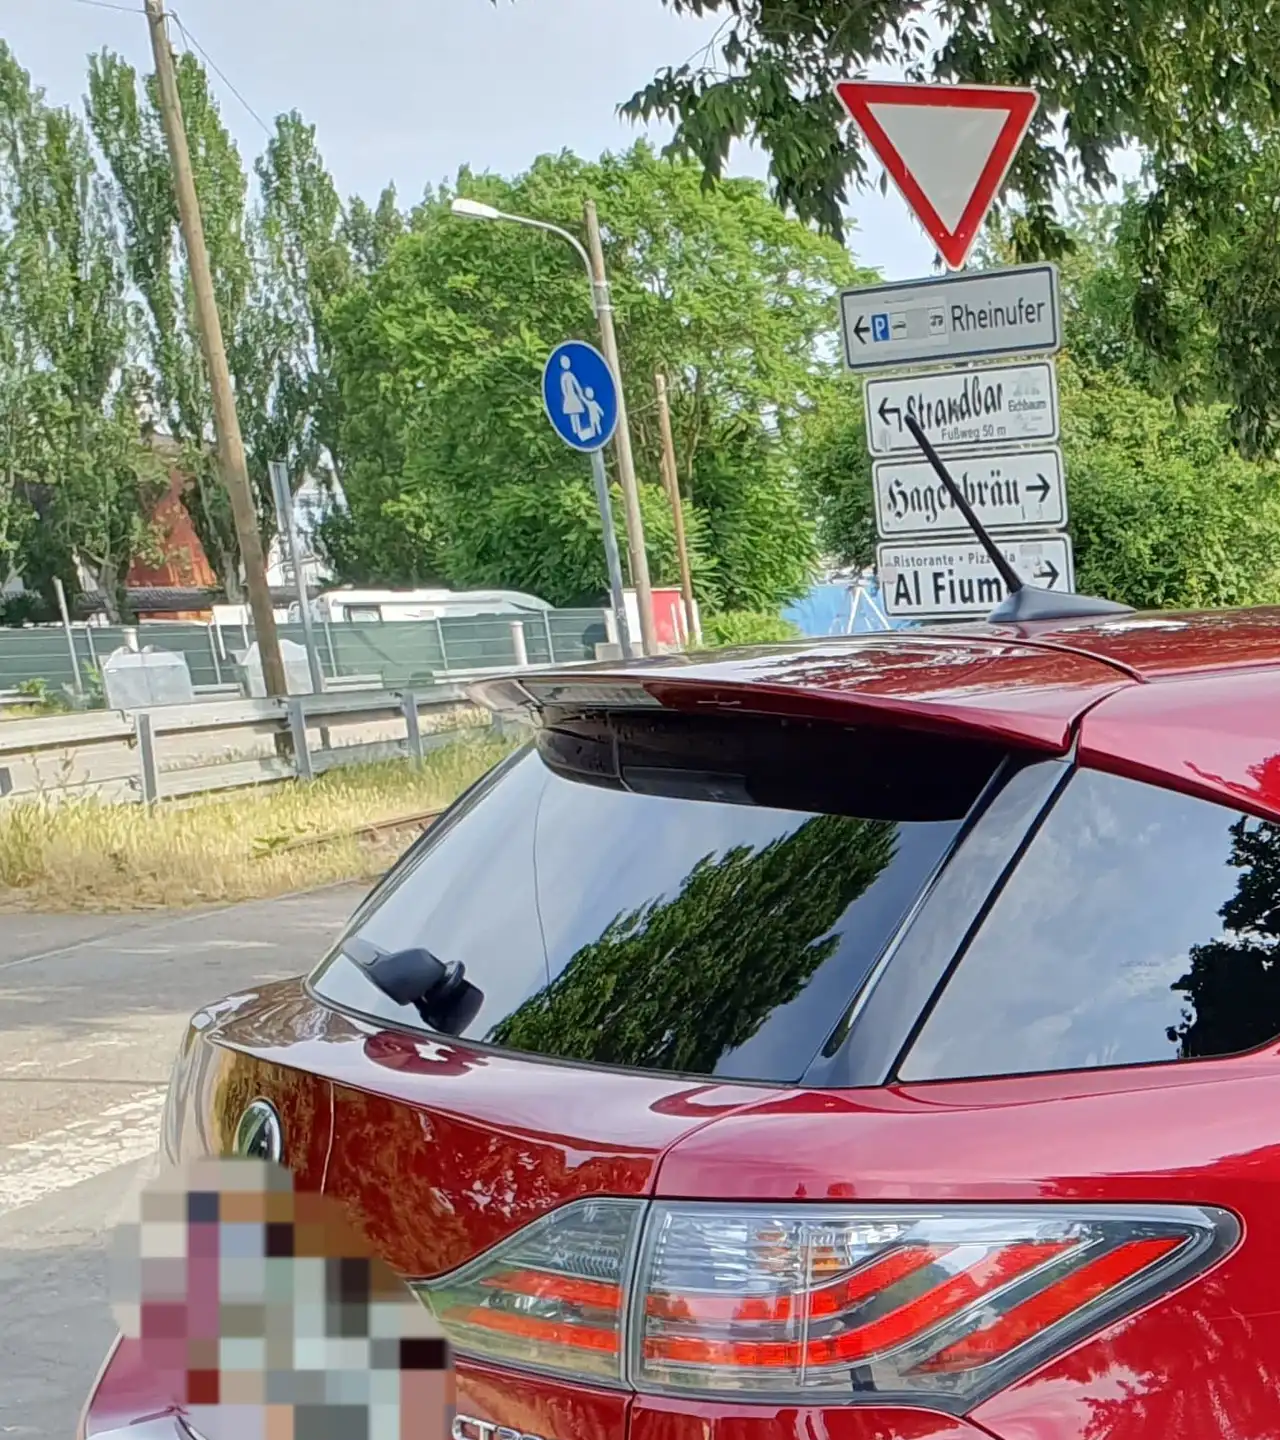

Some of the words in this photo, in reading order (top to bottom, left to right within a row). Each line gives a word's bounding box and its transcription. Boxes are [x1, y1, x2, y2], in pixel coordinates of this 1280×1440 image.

[950, 298, 1046, 332] Rheinufer
[906, 375, 1004, 430] Strandbar
[941, 426, 980, 441] Fußweg
[982, 424, 995, 438] 50
[997, 426, 1006, 436] m
[887, 469, 1020, 523] Hagebräu
[893, 555, 954, 568] Ristorante
[968, 550, 1016, 565] Pizzia
[894, 570, 921, 606] Al
[932, 569, 1010, 604] Fium
